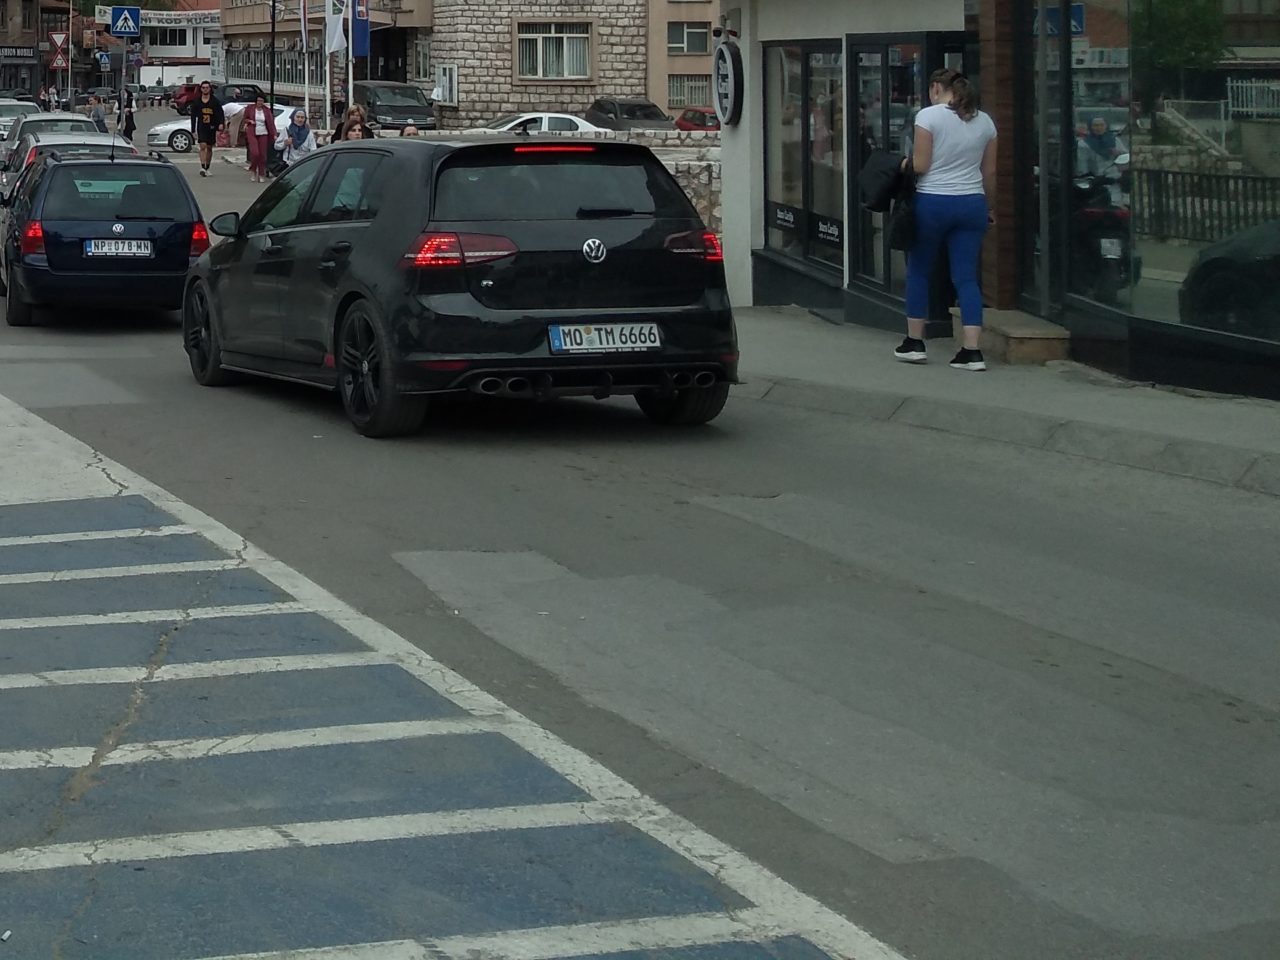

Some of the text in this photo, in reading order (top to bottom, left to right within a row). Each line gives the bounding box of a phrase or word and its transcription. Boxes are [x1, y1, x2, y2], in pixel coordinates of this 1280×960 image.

[93, 241, 106, 251] NP
[562, 328, 584, 347] MO
[594, 327, 616, 346] TM
[619, 326, 657, 345] 6666
